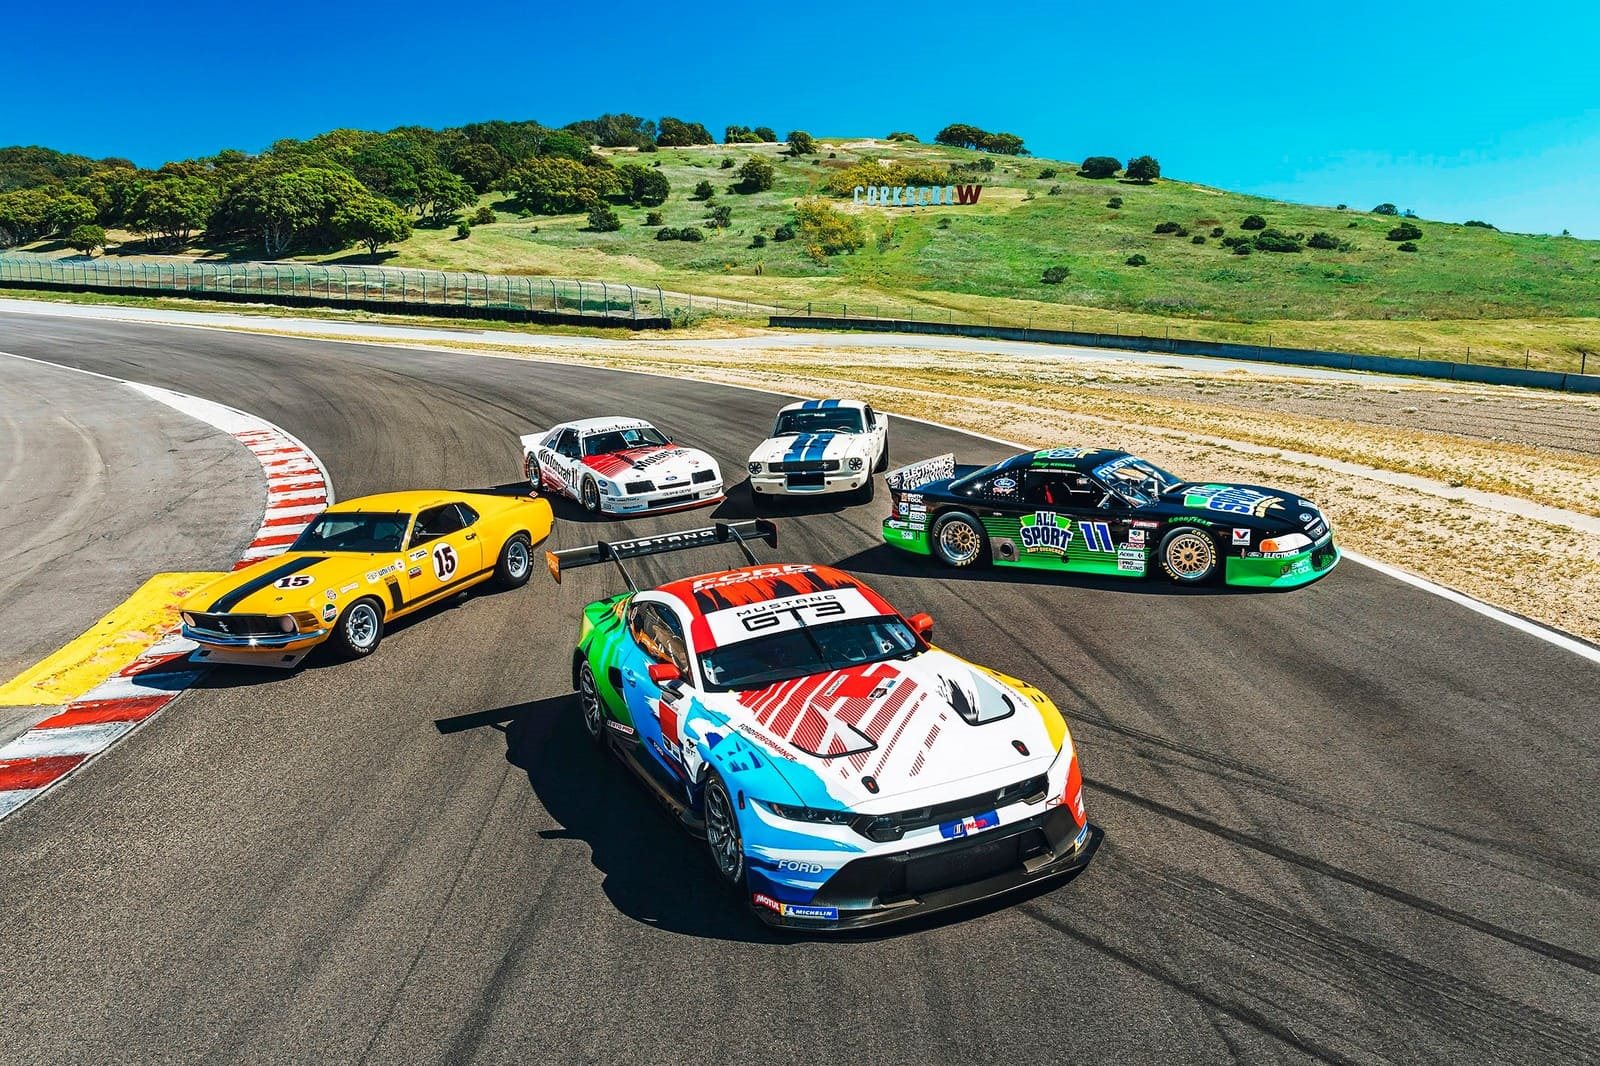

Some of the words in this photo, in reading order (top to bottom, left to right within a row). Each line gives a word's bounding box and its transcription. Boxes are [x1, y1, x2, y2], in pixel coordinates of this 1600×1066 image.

[853, 184, 983, 206] CORKSCREW
[903, 457, 955, 480] ELECTRONICS
[1035, 511, 1057, 527] ALL
[1168, 516, 1212, 527] GOODYEAR
[1021, 526, 1073, 550] SPORT
[1078, 521, 1115, 553] 11
[434, 546, 456, 578] 15
[278, 575, 310, 588] 15
[692, 564, 813, 589] FORD
[736, 594, 837, 617] MUSTANG
[741, 600, 846, 632] GT3
[778, 859, 823, 874] FORD
[756, 894, 780, 911] MOTUL
[795, 909, 832, 917] MICHELIN
